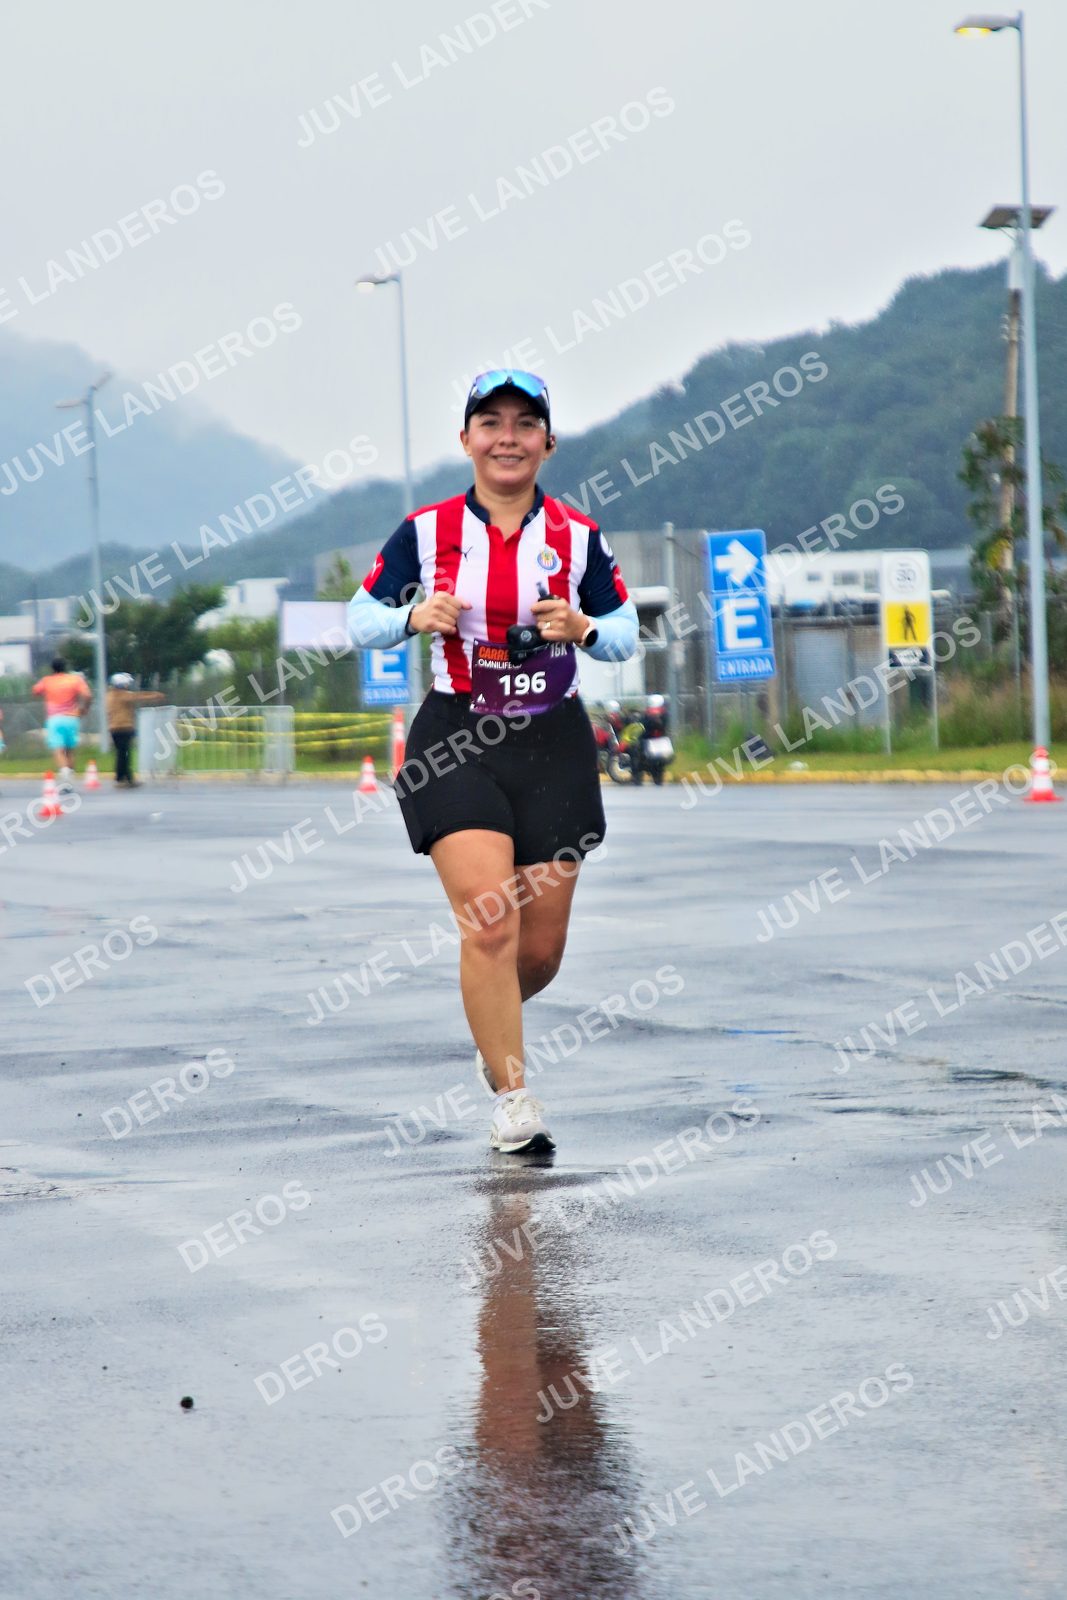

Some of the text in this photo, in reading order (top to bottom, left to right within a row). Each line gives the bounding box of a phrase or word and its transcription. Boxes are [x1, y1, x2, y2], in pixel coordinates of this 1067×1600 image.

[722, 597, 763, 649] E
[371, 641, 406, 680] E
[478, 645, 510, 661] CARRE
[498, 671, 547, 696] 196
